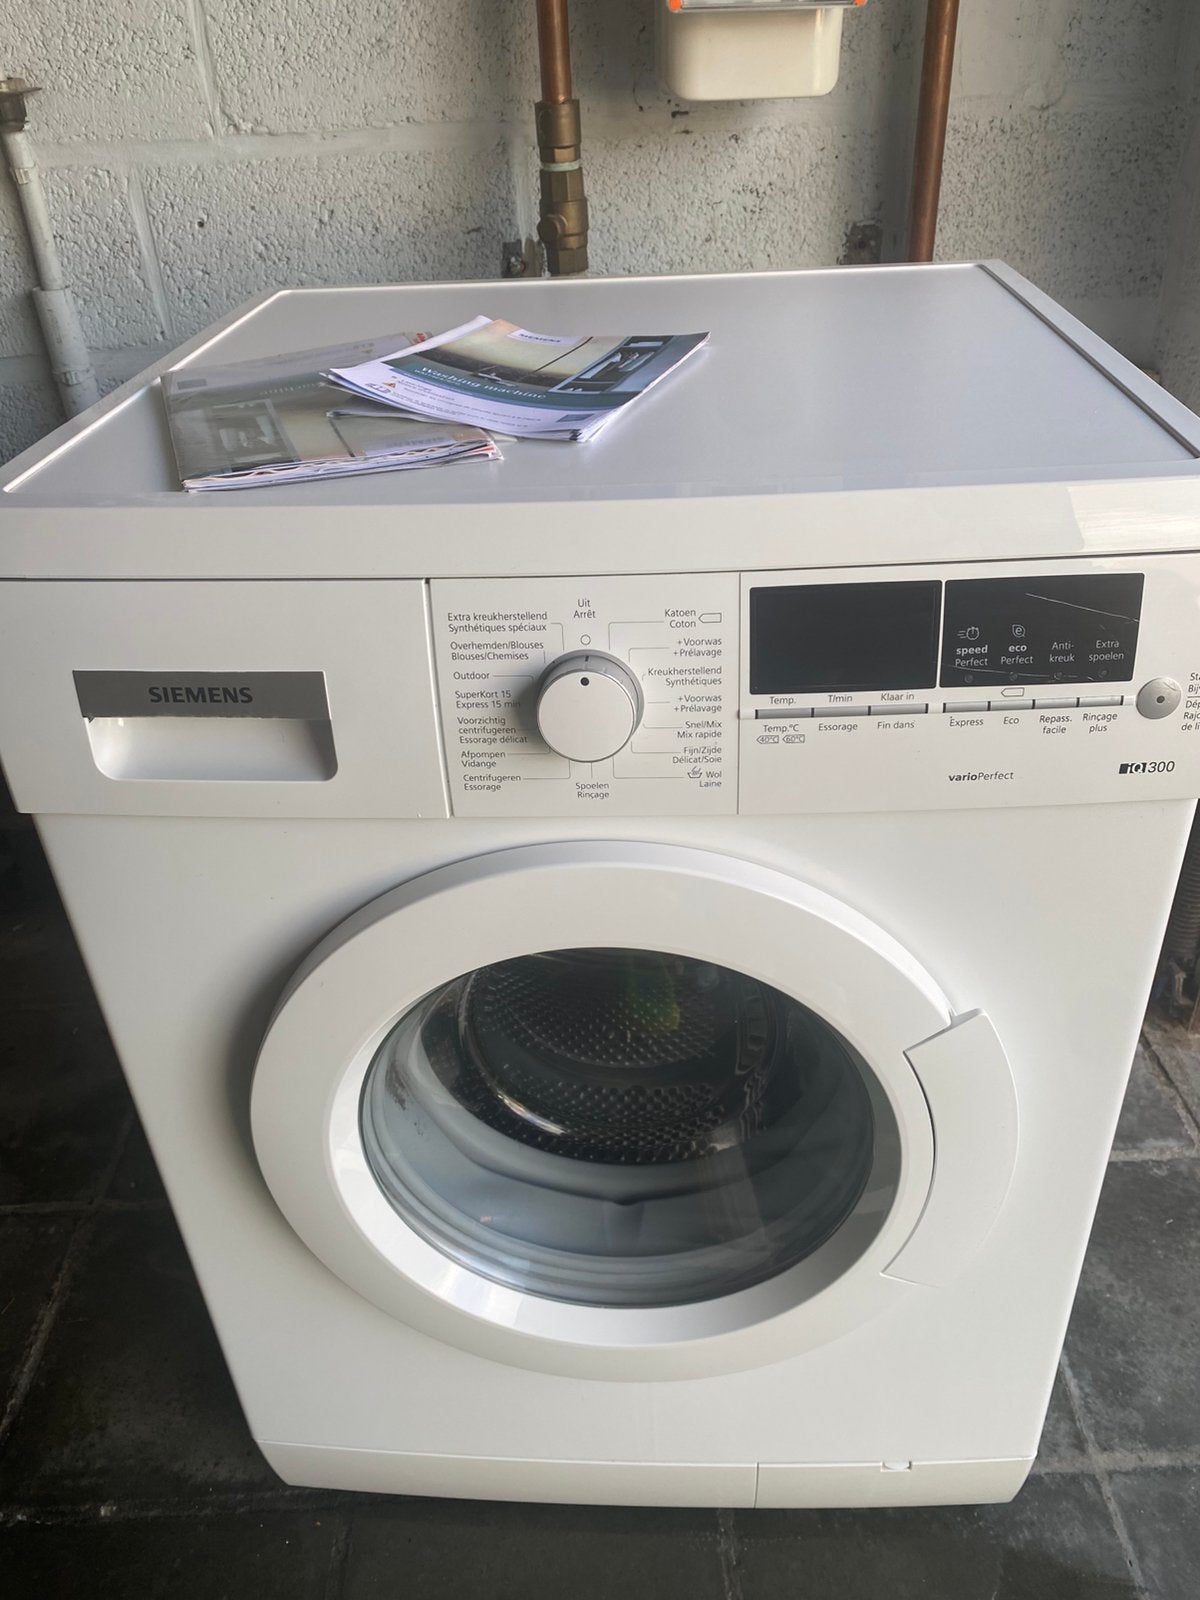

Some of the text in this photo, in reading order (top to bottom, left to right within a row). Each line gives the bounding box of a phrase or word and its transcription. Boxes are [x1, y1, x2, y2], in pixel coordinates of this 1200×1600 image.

[578, 599, 591, 608] Uit
[448, 612, 548, 621] Extra kreukherstellend
[574, 609, 596, 619] Arrêt
[665, 609, 696, 617] Katoen
[448, 622, 547, 634] Synthétiques spéciaux
[669, 620, 696, 628] Coton
[450, 641, 544, 650] Overhemden/Blouses
[1008, 644, 1027, 653] eco
[1052, 641, 1075, 650] Anti-
[1096, 640, 1120, 649] Extra
[956, 645, 988, 656] speed
[451, 652, 529, 660] Blouses/Chemises
[1001, 655, 1033, 665] Perfect
[1049, 653, 1075, 663] kreuk
[1088, 651, 1124, 662] spoelen
[955, 658, 988, 667] Perfect
[453, 672, 490, 680] Outdoor
[648, 667, 722, 676] Kreukherstellend
[665, 677, 722, 688] Synthétiques
[149, 686, 254, 704] SIEMENS
[455, 690, 512, 699] SuperKort 15
[881, 693, 915, 701] Klaar in
[456, 701, 489, 710] Express
[492, 700, 502, 708] 15
[770, 696, 797, 705] Temp.
[457, 716, 506, 726] Voorzichtig
[949, 717, 984, 728] Express
[1003, 716, 1019, 725] Eco
[1039, 715, 1072, 725] Repass.
[1083, 712, 1118, 724] Rinçage
[818, 723, 858, 732] Essorage
[893, 721, 915, 729] dans
[1042, 725, 1067, 734] facile
[1089, 724, 1107, 734] plus
[1182, 722, 1192, 730] de
[458, 726, 516, 736] centrifugeren
[695, 731, 722, 739] rapide
[460, 736, 528, 745] Essorage délicat
[461, 750, 506, 759] Afpompen
[683, 747, 722, 755] Fijn/Zijde
[462, 760, 496, 769] Vidange
[463, 774, 521, 784] Centrifugeren
[949, 770, 1014, 782] varioPerfect
[464, 784, 502, 793] Essorage
[575, 782, 609, 791] Spoelen
